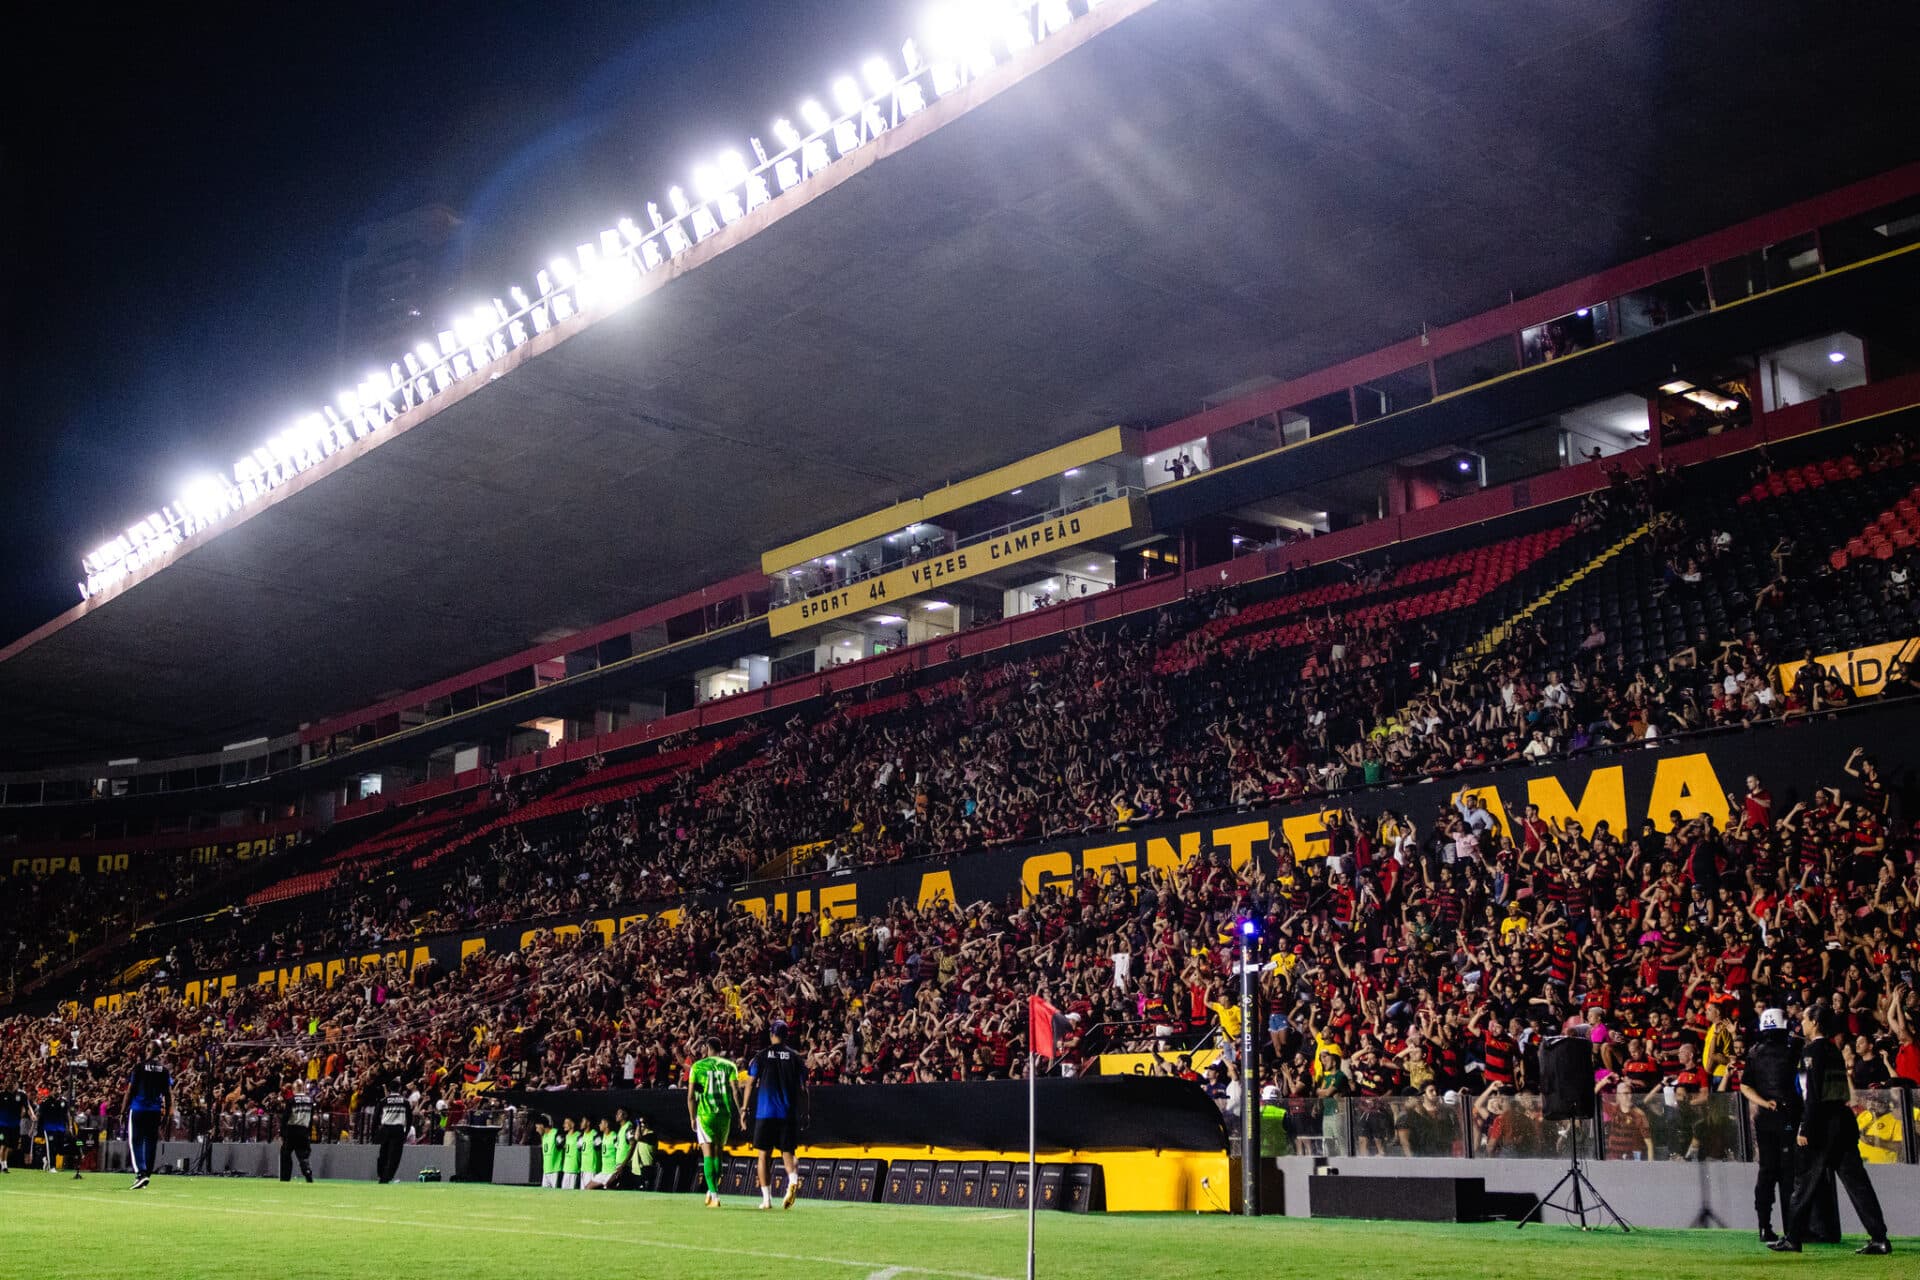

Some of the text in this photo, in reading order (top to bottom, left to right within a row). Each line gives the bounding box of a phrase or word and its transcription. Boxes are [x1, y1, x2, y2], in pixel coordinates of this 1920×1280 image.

[802, 517, 1080, 619] SPORT 44 VEZES CAMPEÃO
[1827, 651, 1903, 687] AÍDA
[12, 856, 80, 876] COPA
[917, 870, 955, 912] A
